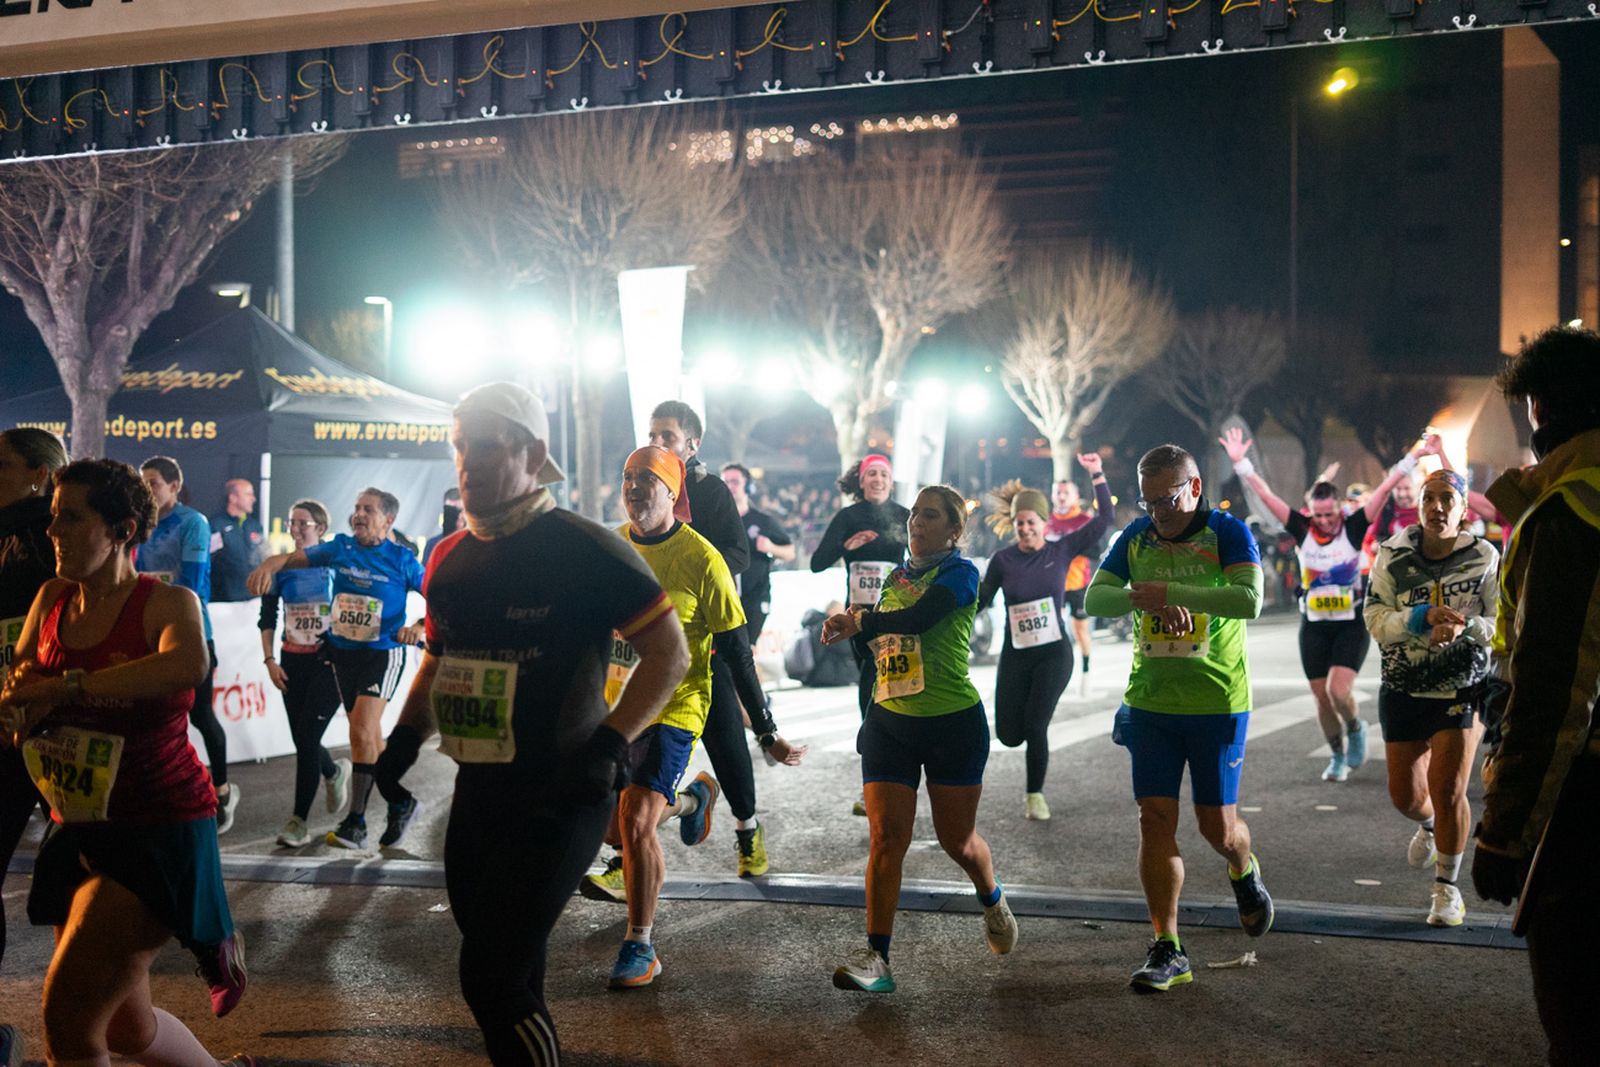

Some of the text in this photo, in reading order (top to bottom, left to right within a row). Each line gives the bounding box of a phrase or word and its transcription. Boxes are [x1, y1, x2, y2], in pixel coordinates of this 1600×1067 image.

[1316, 597, 1344, 608] 5891
[295, 617, 323, 630] 2875
[339, 611, 372, 627] 6502
[1018, 615, 1048, 633] 6382
